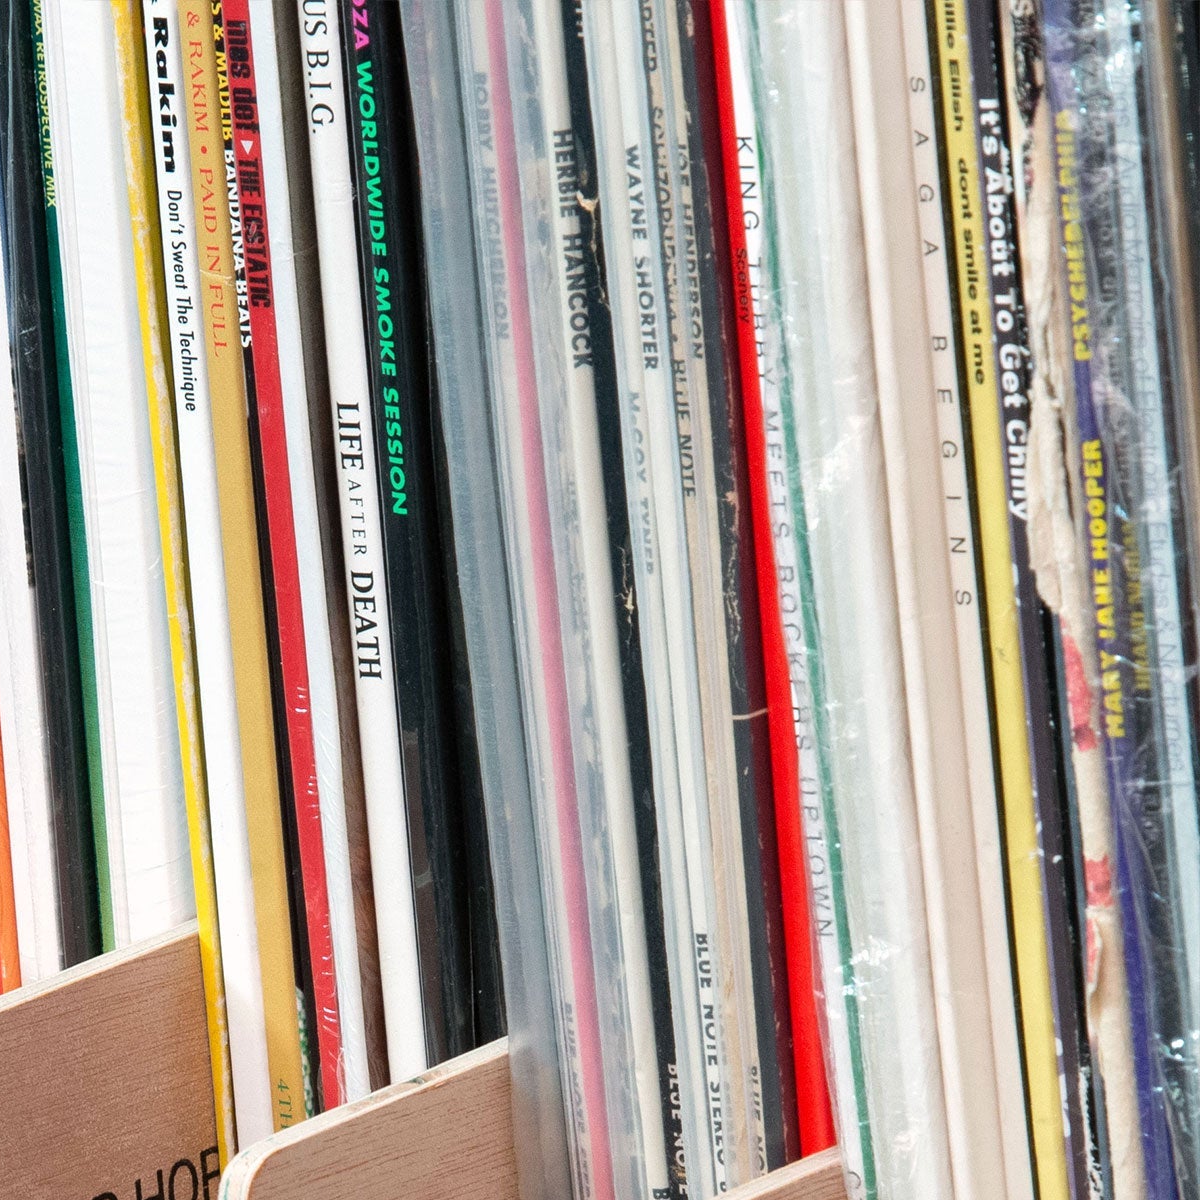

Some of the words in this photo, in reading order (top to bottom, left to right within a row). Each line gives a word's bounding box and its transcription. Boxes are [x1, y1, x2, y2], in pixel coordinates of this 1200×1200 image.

[186, 11, 200, 28] &
[213, 25, 225, 41] &
[226, 20, 252, 79] mos
[152, 17, 178, 173] Rakim
[188, 40, 209, 132] RAKIM
[215, 50, 232, 141] MADLIB
[232, 87, 260, 135] def
[306, 49, 334, 134] B.I.G.
[474, 71, 492, 152] BOBBY
[949, 59, 964, 132] Eilish
[35, 42, 53, 171] RETROSPECTIVE
[44, 175, 58, 208] MIX
[355, 61, 387, 257] WORLDWIDE
[978, 98, 1001, 157] It's
[199, 168, 219, 234] PAID
[224, 149, 246, 270] BANDANA
[238, 158, 262, 197] THE
[553, 130, 578, 218] HERBIE
[625, 144, 647, 241] WAYNE
[957, 158, 972, 219] dont
[167, 190, 183, 236] Don't
[984, 166, 1015, 277] About
[171, 240, 187, 290] Sweat
[206, 246, 222, 277] IN
[242, 204, 272, 309] ECSTATIC
[482, 167, 510, 339] HUTCHERSON
[682, 203, 704, 359] HENDERSON
[736, 247, 751, 324] Scenery
[962, 229, 978, 301] smile
[175, 295, 193, 325] The
[208, 283, 228, 358] FULL
[236, 279, 252, 347] BEATS
[373, 266, 397, 377] SMOKE
[562, 233, 595, 369] HANCOCK
[634, 256, 659, 371] SHORTER
[970, 309, 983, 335] at
[994, 288, 1016, 333] To
[179, 330, 199, 412] Technique
[910, 77, 940, 256] SAGA
[932, 335, 972, 606] BEGINS
[973, 343, 985, 385] me
[999, 343, 1029, 408] Get
[674, 358, 691, 420] BLUE
[336, 401, 365, 471] LIFE
[383, 387, 408, 516] SESSION
[679, 434, 697, 498] NOTE
[347, 478, 368, 556] AFTER
[735, 136, 760, 231] KING
[764, 410, 790, 538] MEETS
[800, 776, 833, 937] UPTOWN
[1082, 439, 1111, 560] HOOPER
[350, 570, 383, 681] DEATH
[1094, 568, 1116, 640] JANE
[1100, 649, 1126, 738] MARY
[695, 933, 712, 988] BLUE
[703, 1004, 718, 1066] NOTE
